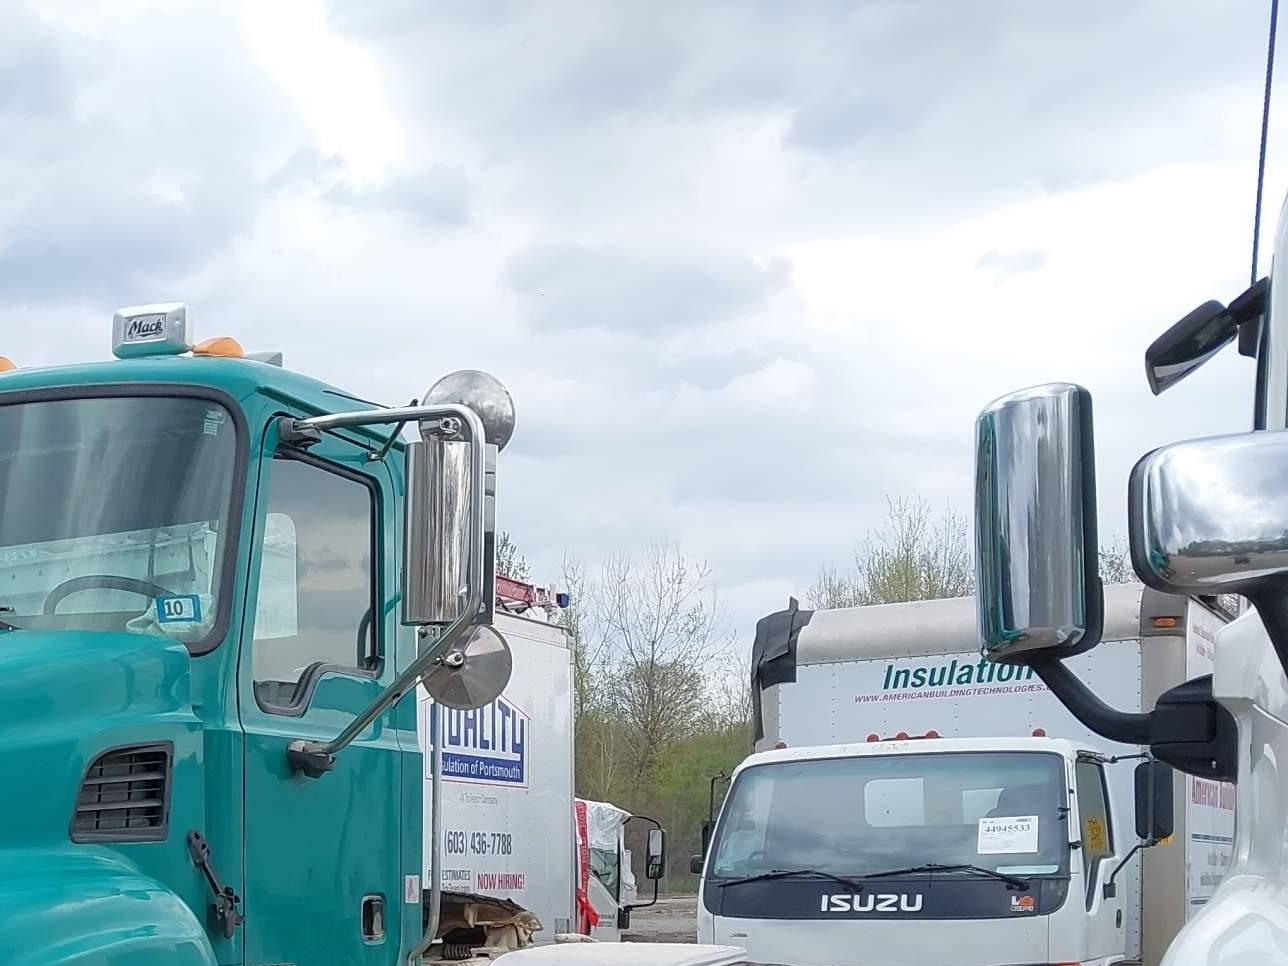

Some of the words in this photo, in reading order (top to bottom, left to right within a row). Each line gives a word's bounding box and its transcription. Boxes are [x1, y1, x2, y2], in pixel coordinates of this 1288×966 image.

[127, 318, 163, 337] Mack
[165, 600, 183, 616] 10
[883, 660, 1033, 690] Insulation
[470, 760, 479, 775] of
[479, 761, 521, 779] Portsmouth
[984, 824, 1031, 833] 44945533
[444, 829, 468, 856] (603)
[470, 832, 512, 856] 436-7788
[477, 873, 497, 890] NOW
[497, 874, 525, 890] HIRING!
[821, 894, 923, 912] ISUZU
